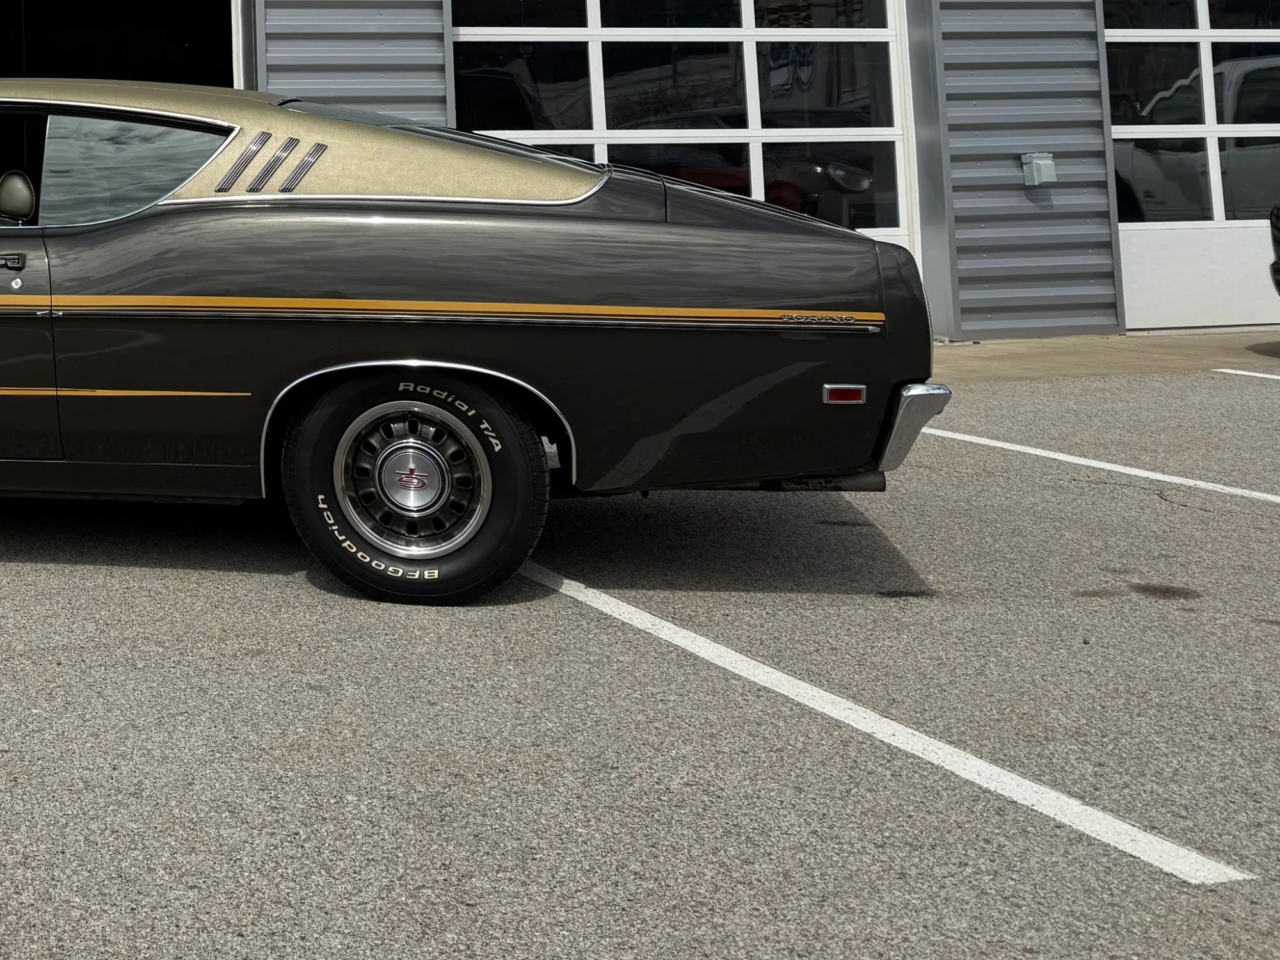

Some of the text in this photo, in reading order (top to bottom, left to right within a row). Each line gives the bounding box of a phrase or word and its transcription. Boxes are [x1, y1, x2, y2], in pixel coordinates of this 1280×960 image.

[398, 381, 503, 453] Radial T/A
[317, 494, 440, 580] BFGoodrich
